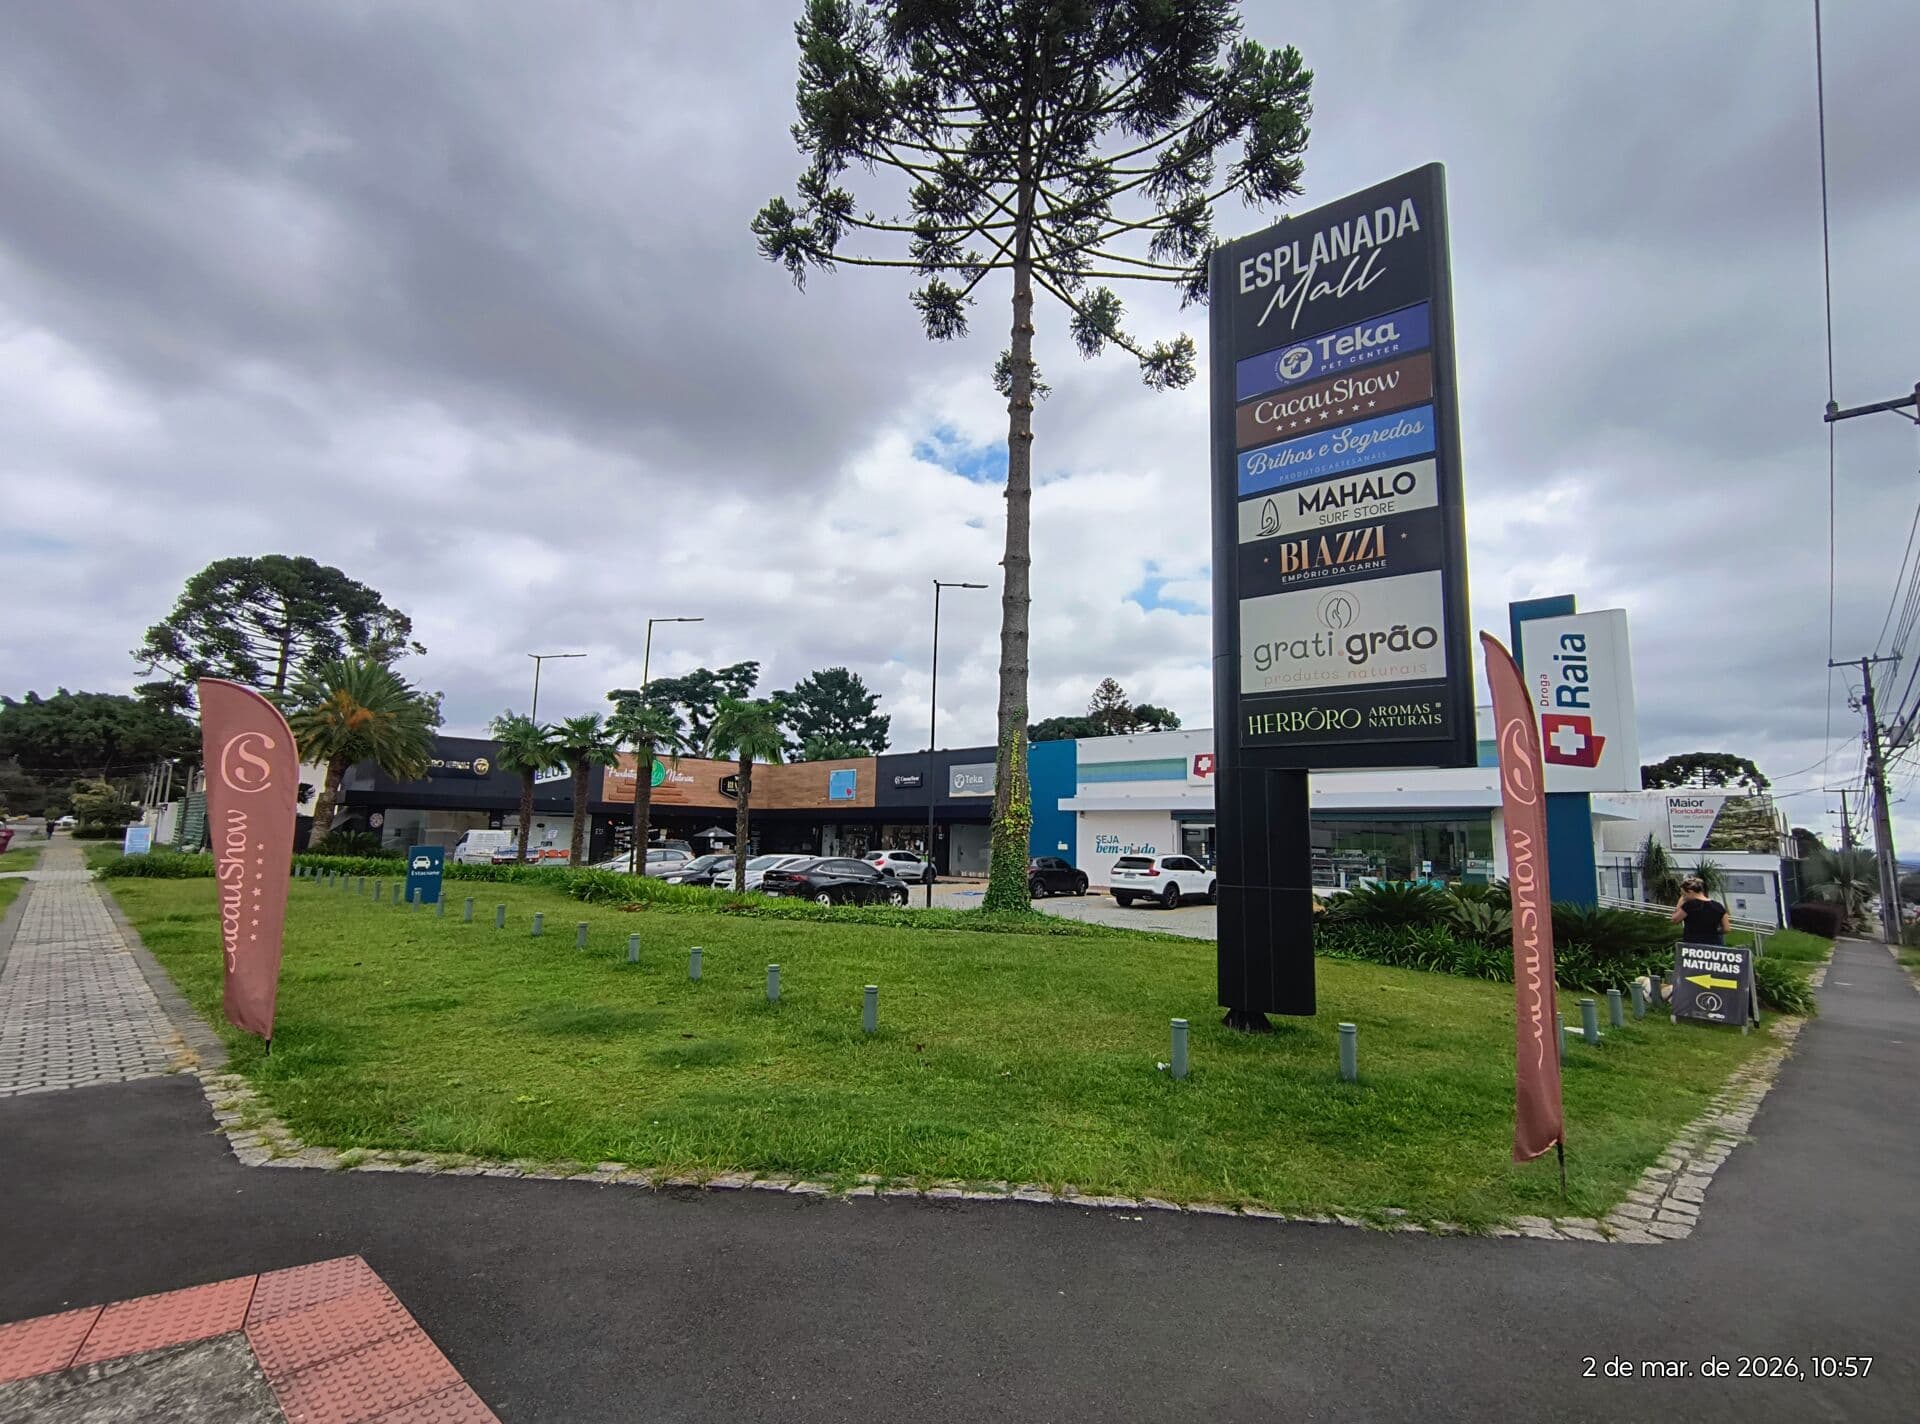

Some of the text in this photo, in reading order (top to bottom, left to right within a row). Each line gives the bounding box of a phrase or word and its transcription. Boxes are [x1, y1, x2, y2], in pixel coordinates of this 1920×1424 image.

[1240, 198, 1420, 294] ESPLANADA
[1257, 248, 1386, 330] Mall
[1316, 321, 1400, 360] Teka
[1321, 344, 1399, 372] PET CENTER
[1247, 419, 1425, 476] Brilhos e Segredos
[1298, 471, 1416, 516] MAHALO
[1319, 501, 1395, 526] SURF STORE
[1280, 524, 1386, 574] BIAZZI
[1281, 559, 1387, 583] EMPÓRIO DA CARNE
[1264, 663, 1428, 688] produtos naturais
[1553, 633, 1590, 709] Raia
[1540, 674, 1551, 707] Droga
[1368, 713, 1442, 728] NATURAIS
[1369, 703, 1431, 717] AROMAS
[965, 774, 983, 783] Teka
[1669, 798, 1704, 807] Maior
[1096, 835, 1119, 844] SEJA
[1682, 947, 1743, 963] PRODUTOS
[1683, 958, 1740, 974] NATURAIS
